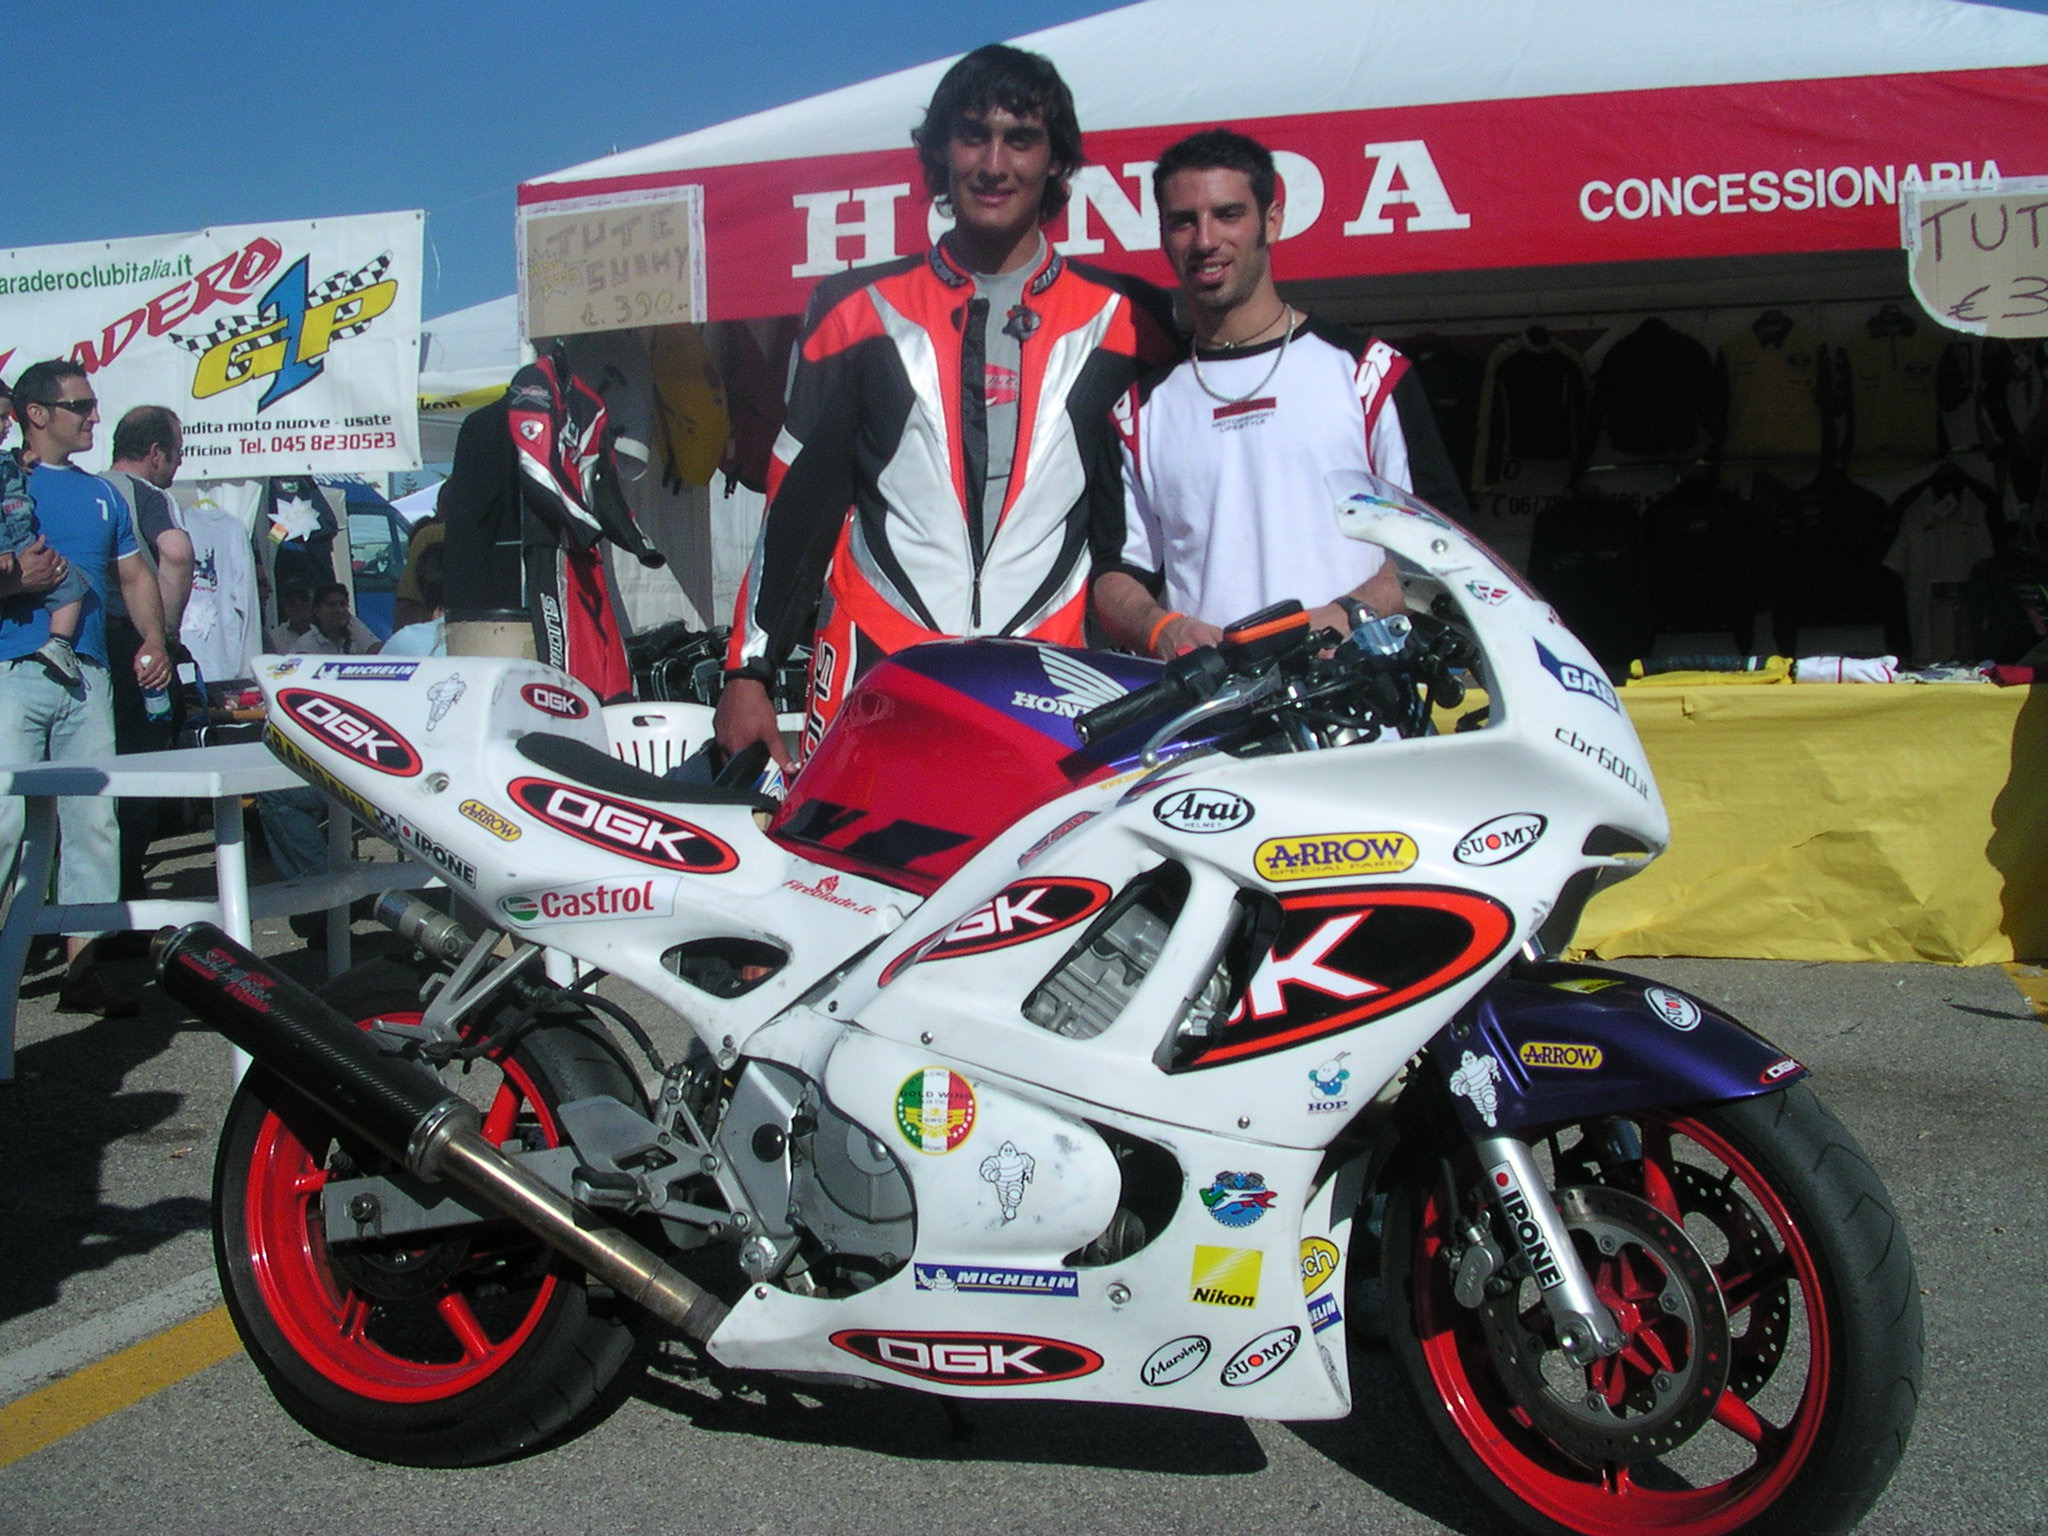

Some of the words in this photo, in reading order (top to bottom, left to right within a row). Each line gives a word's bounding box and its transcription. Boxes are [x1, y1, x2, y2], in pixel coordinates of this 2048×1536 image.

[792, 138, 1470, 278] HNDA
[182, 421, 223, 435] ndita
[228, 416, 272, 433] moto
[276, 412, 330, 429] nuove
[344, 409, 392, 428] usate
[240, 438, 267, 454] Tel.
[271, 435, 306, 453] 045
[311, 431, 396, 451] 8230523
[340, 663, 418, 676] MICHELIN
[534, 687, 578, 715] OGK
[1011, 690, 1093, 719] HON
[296, 697, 400, 762] OGK
[462, 803, 518, 839] ARROW
[1163, 793, 1242, 821] Arai
[546, 788, 698, 863] OGK
[1459, 822, 1540, 857] SUOMY
[414, 826, 475, 886] IPONE
[1265, 838, 1405, 869] ARROW
[542, 880, 655, 919] Castrol
[1524, 1046, 1598, 1067] ARROW
[1308, 1101, 1348, 1112] HOP
[1502, 1187, 1566, 1290] IPONE
[957, 1271, 1076, 1289] MICHELIN
[1193, 1287, 1256, 1308] Nikon
[877, 1337, 1045, 1376] OGK
[1223, 1333, 1296, 1381] SUOMY
